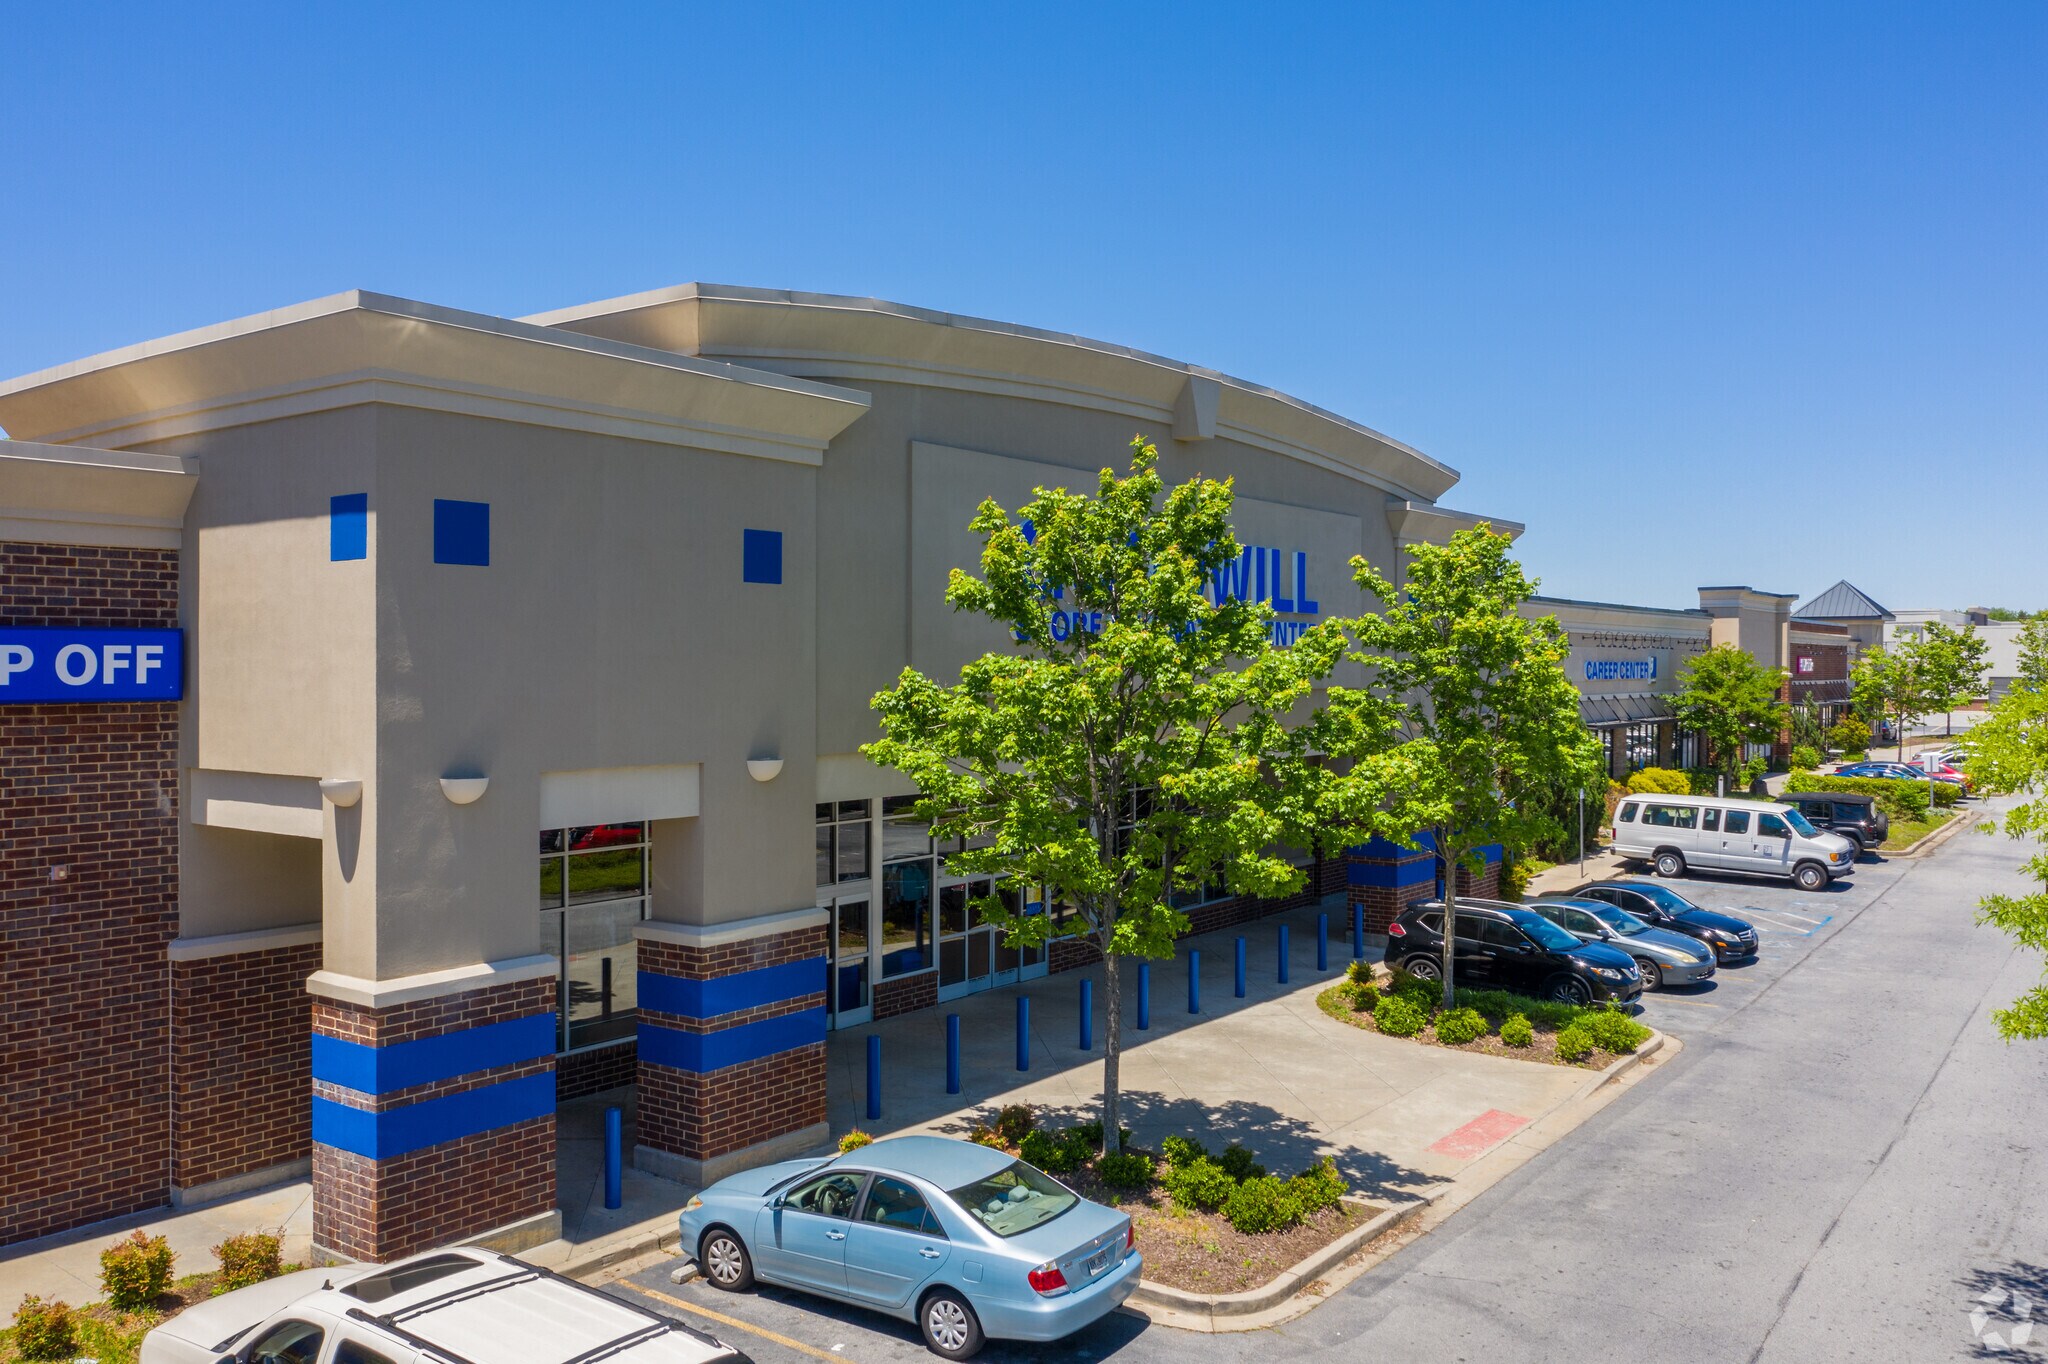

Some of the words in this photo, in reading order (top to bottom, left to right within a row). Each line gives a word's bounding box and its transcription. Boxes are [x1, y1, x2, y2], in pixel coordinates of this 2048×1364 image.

[55, 643, 163, 686] OFF
[1585, 661, 1618, 680] CAREER
[1620, 661, 1648, 679] CENTER
